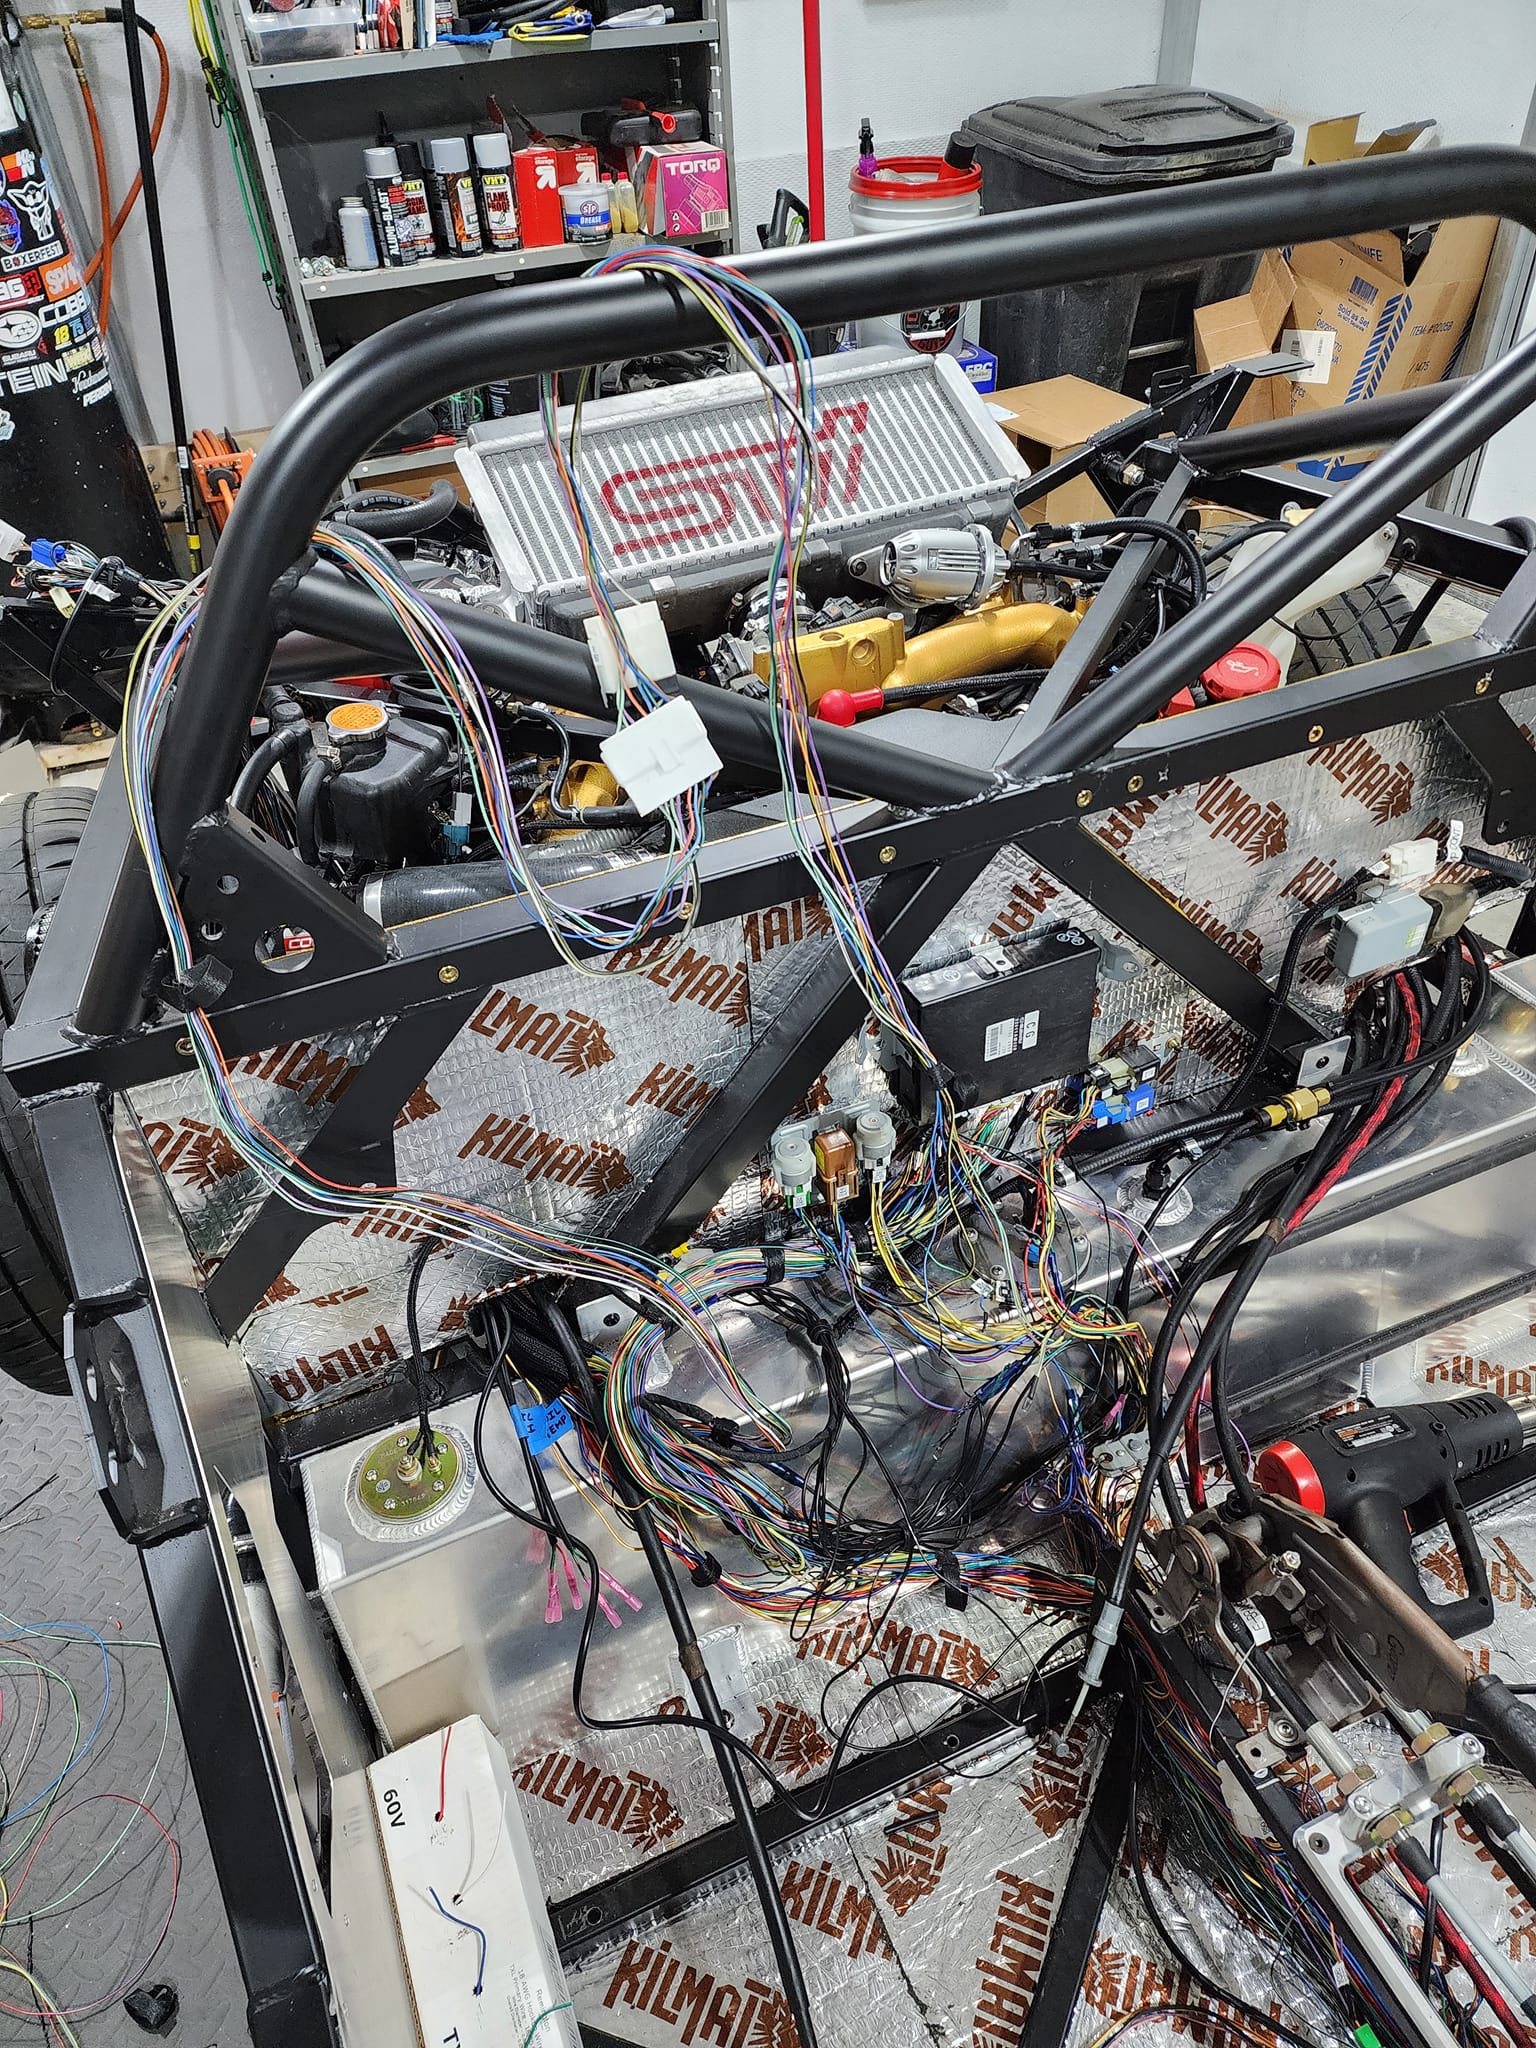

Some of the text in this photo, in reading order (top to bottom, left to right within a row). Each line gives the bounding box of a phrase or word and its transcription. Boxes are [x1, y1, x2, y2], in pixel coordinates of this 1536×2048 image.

[665, 158, 721, 176] TORQ
[484, 176, 505, 185] VHT
[486, 191, 508, 202] FLAME
[488, 201, 510, 213] PROOF
[583, 203, 597, 214] STP
[38, 289, 87, 328] COBB
[1338, 303, 1351, 316] Sold
[1352, 311, 1358, 320] as
[1359, 315, 1370, 328] Set
[54, 325, 70, 345] 18
[457, 1113, 612, 1186] KILMAT
[383, 1788, 406, 1829] 60V
[603, 1939, 772, 2048] KILMAT
